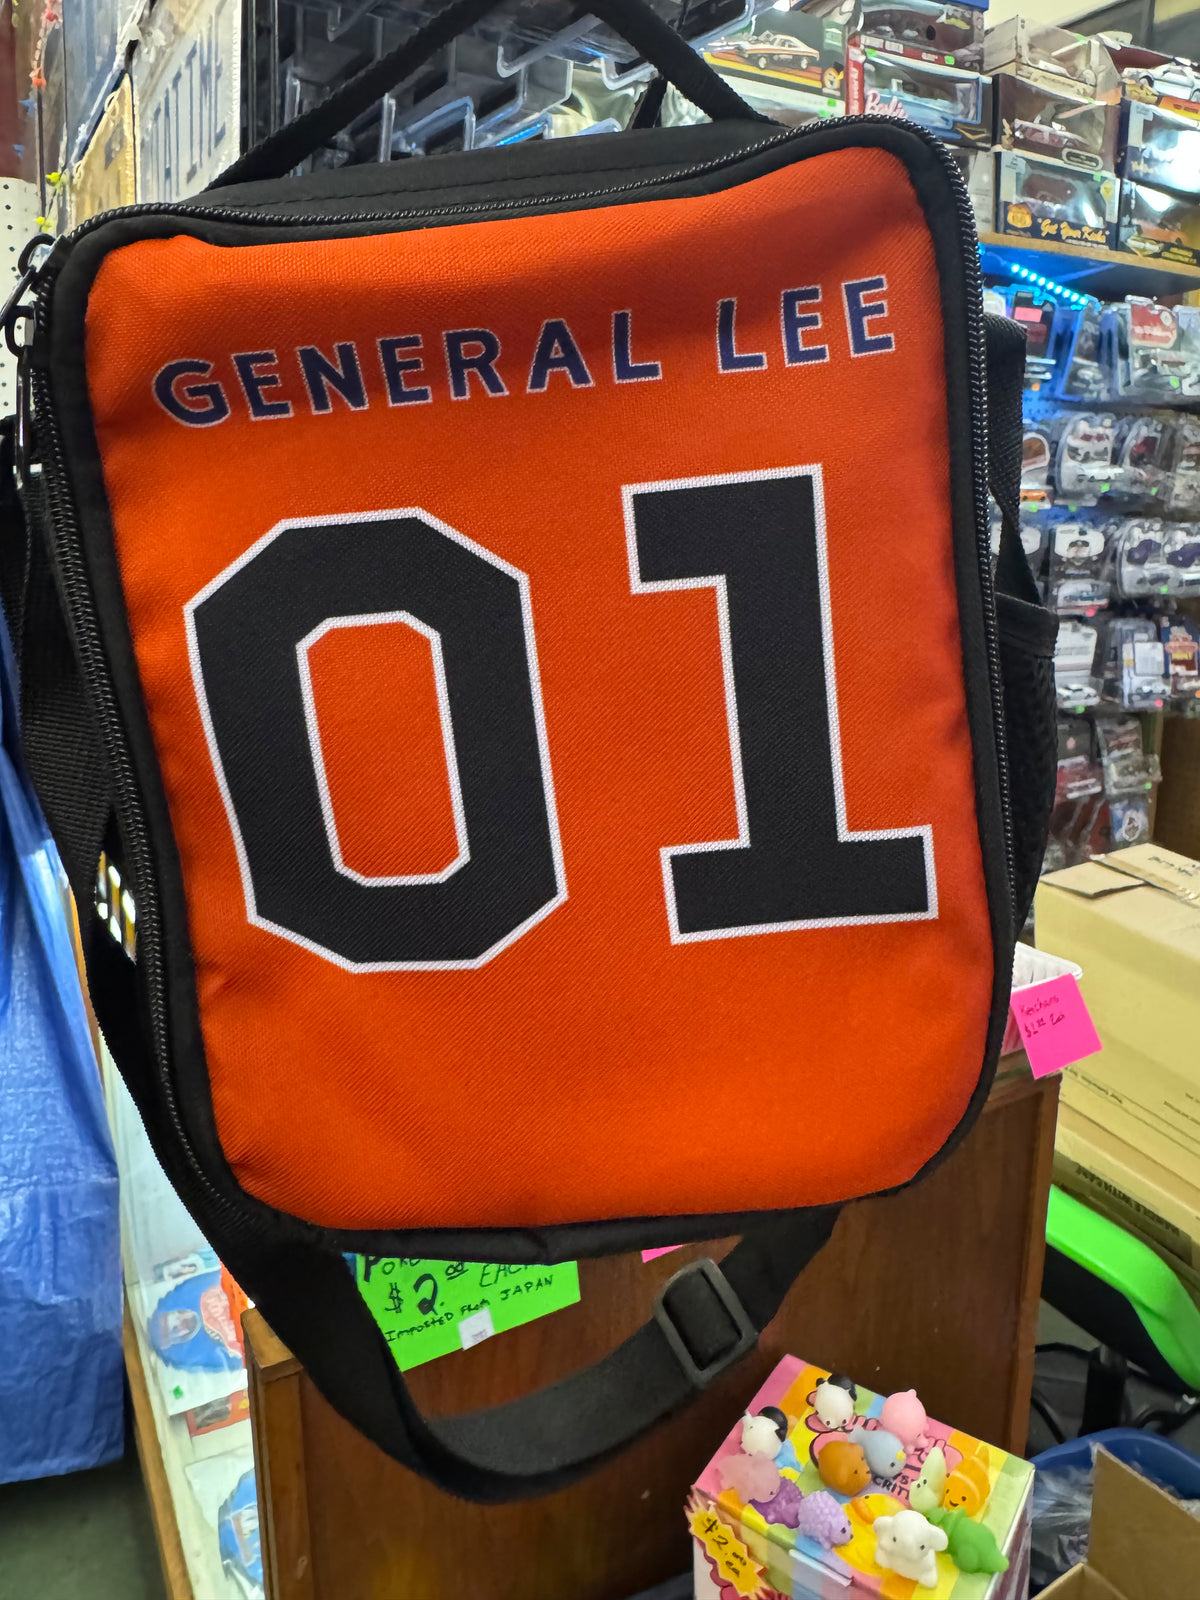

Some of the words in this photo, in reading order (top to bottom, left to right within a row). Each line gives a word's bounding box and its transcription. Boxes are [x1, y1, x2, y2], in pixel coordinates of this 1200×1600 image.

[152, 309, 663, 429] GENERAL
[716, 274, 896, 375] LEE
[183, 463, 939, 975] 01
[499, 1274, 554, 1301] JAPAN
